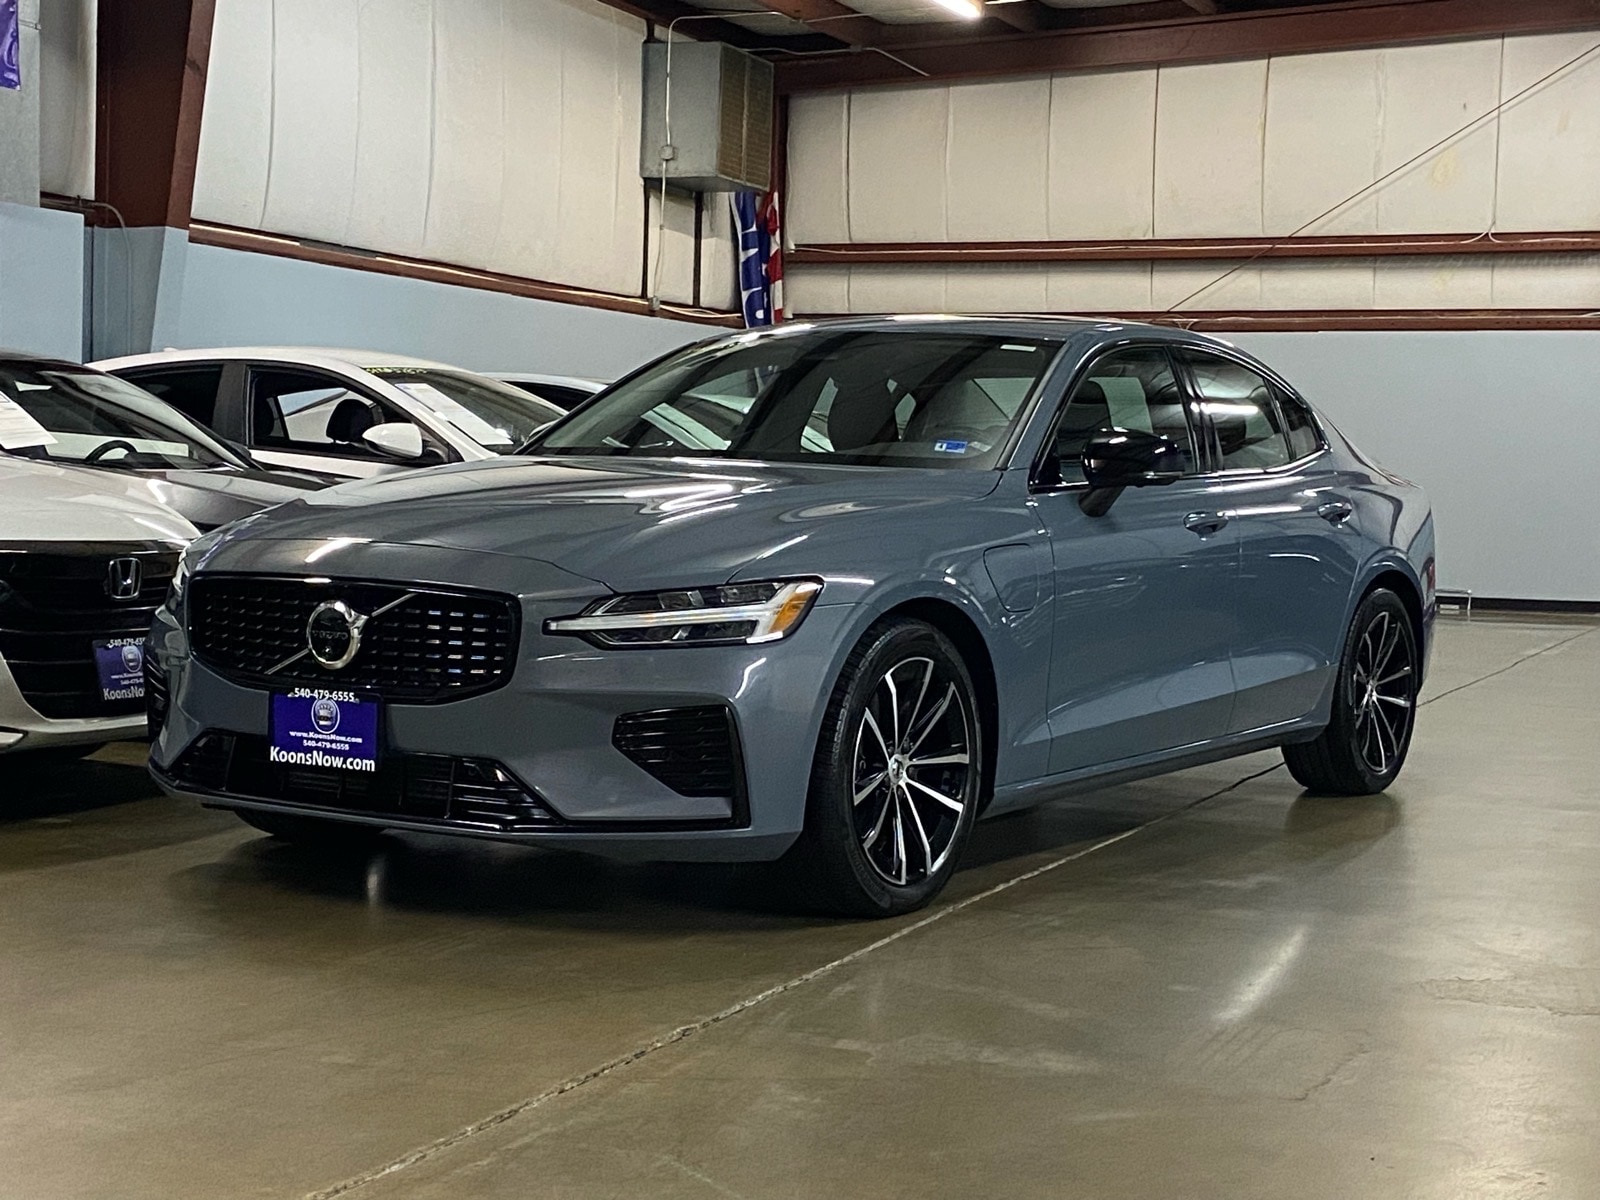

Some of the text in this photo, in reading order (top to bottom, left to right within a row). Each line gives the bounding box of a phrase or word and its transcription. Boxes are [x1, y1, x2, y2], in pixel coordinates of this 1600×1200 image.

[103, 685, 146, 700] KoonsNo
[294, 687, 355, 702] 540-479-6555
[289, 731, 363, 743] www.KoonsNow.com
[303, 740, 350, 751] 540-479-6555
[269, 746, 376, 772] KoonsNow.com
